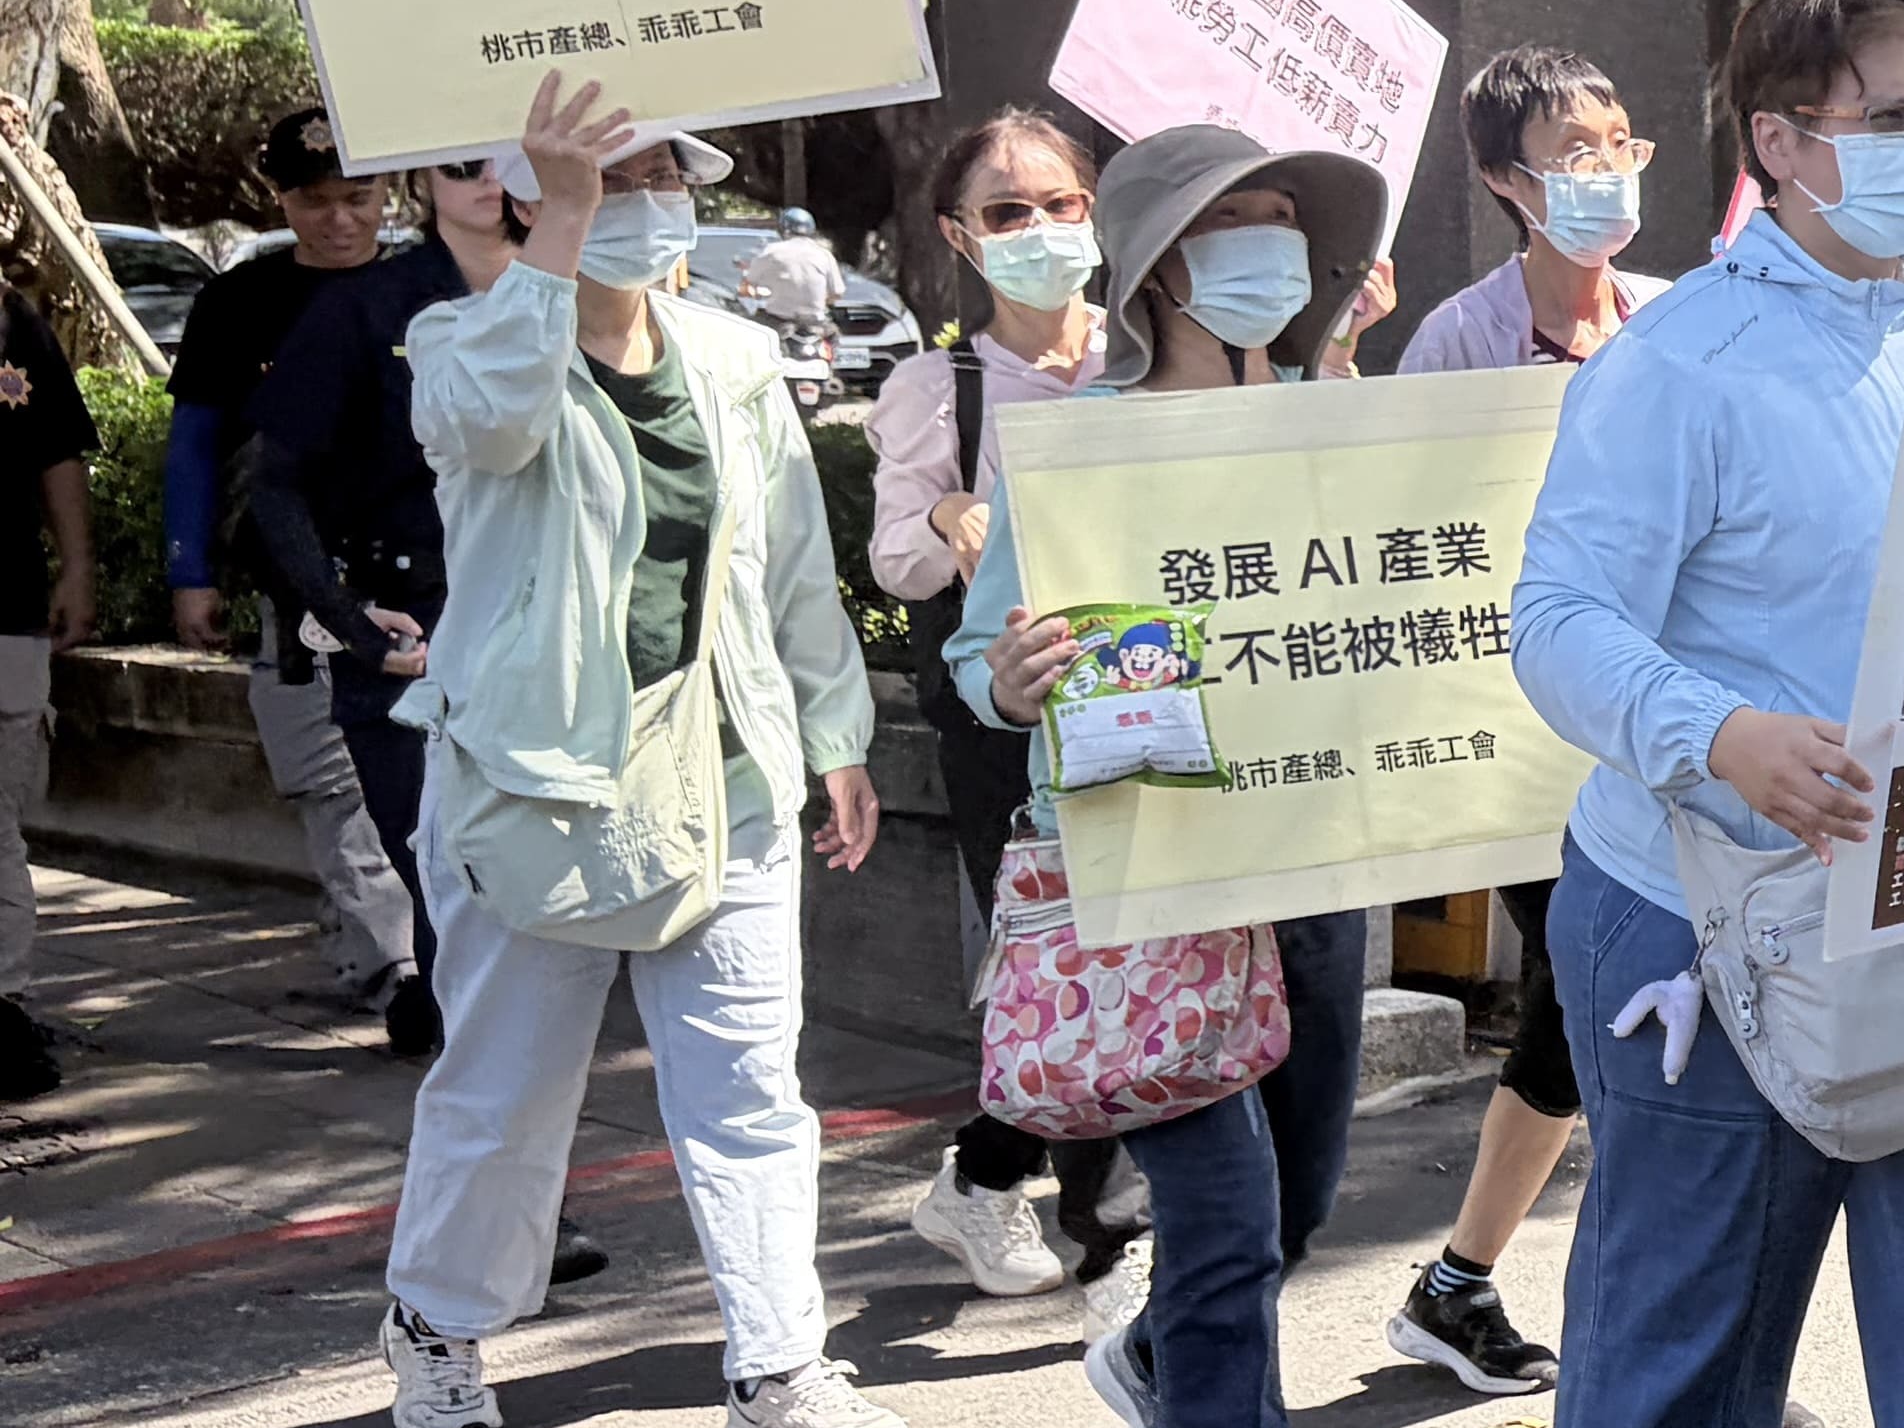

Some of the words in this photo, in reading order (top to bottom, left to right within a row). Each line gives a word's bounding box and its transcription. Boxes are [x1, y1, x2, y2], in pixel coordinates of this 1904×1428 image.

[480, 1, 765, 64] 桃市產總、乖乖工會
[1160, 541, 1281, 605] 發展
[1299, 536, 1360, 590] AI
[1377, 522, 1492, 586] 產業
[1202, 601, 1511, 688] 不能被犧牲
